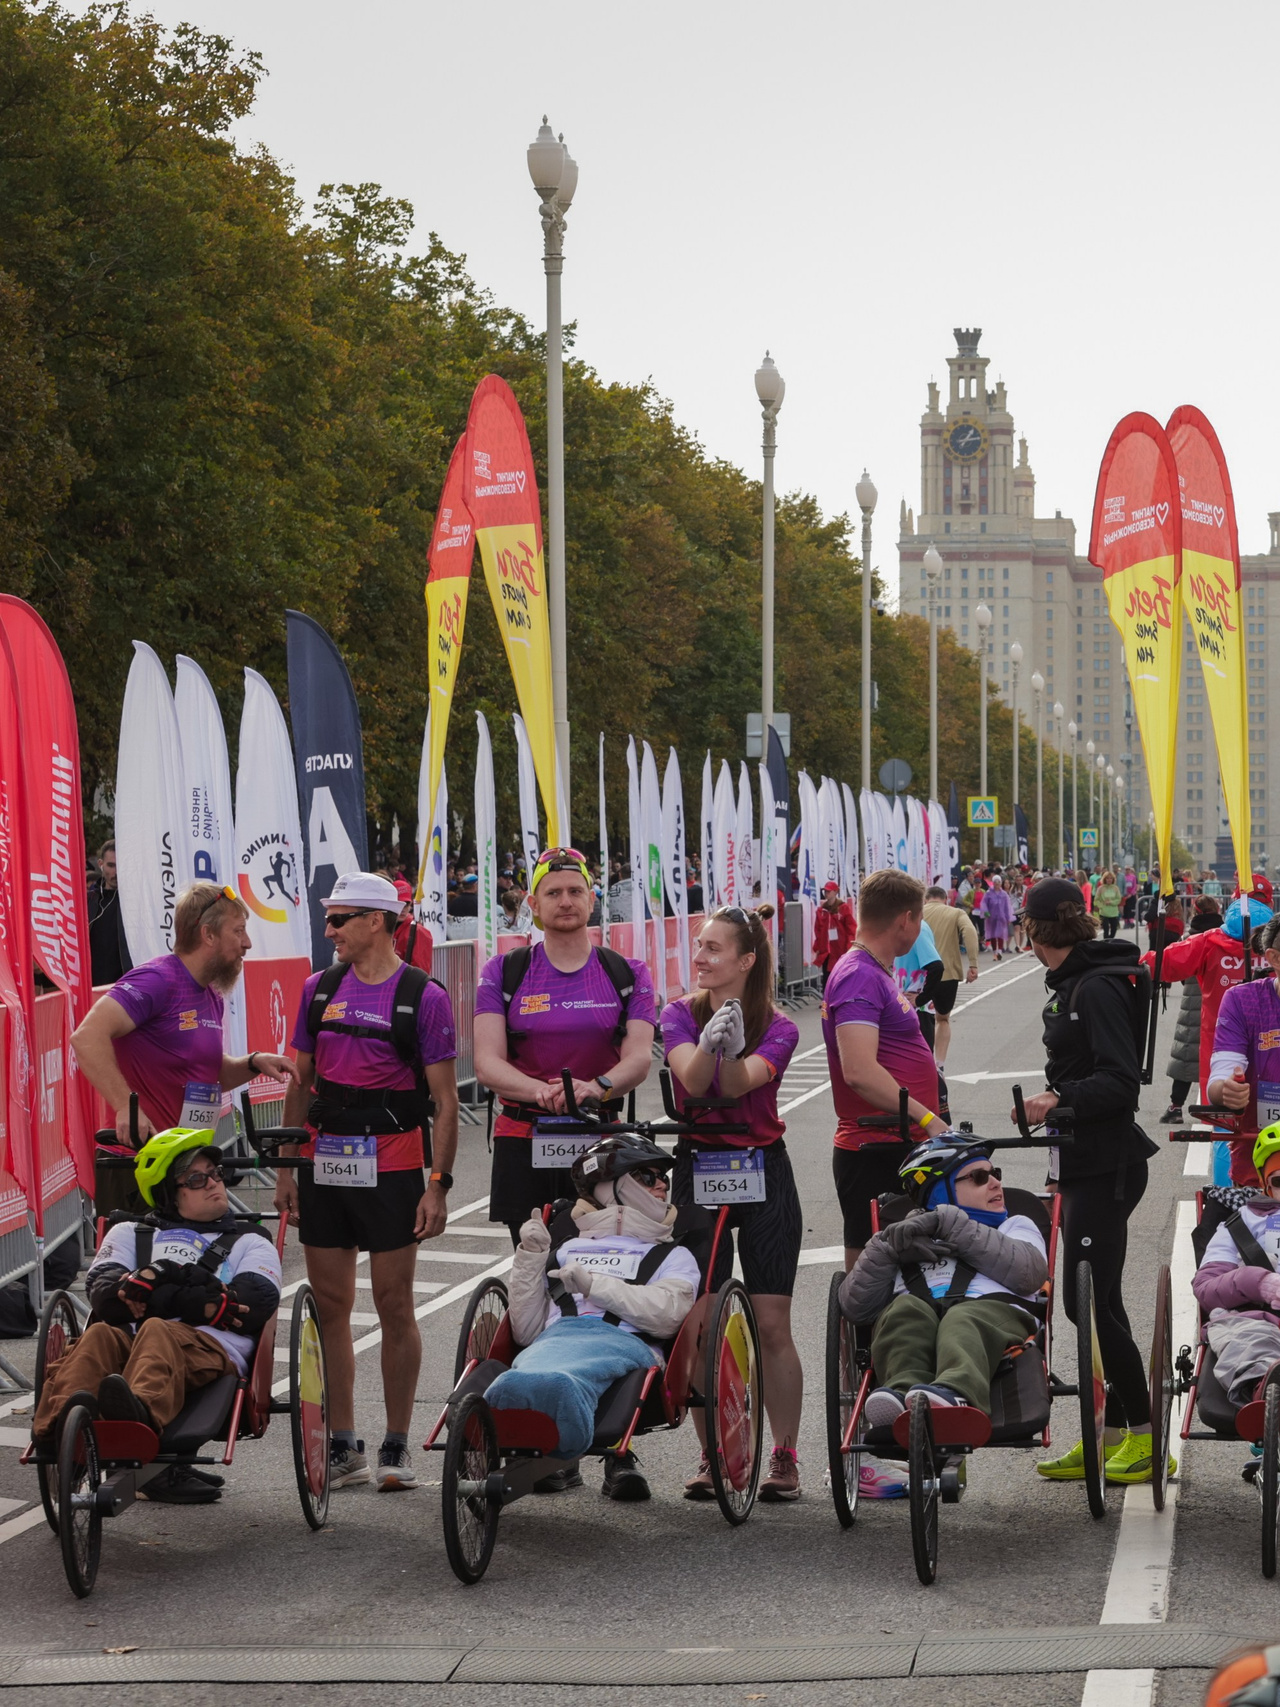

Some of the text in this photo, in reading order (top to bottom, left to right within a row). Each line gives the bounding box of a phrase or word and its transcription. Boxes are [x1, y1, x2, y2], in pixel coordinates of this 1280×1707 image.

[541, 1144, 585, 1156] 15644
[322, 1162, 358, 1175] 15641
[702, 1178, 747, 1192] 15634
[575, 1256, 621, 1266] 15650
